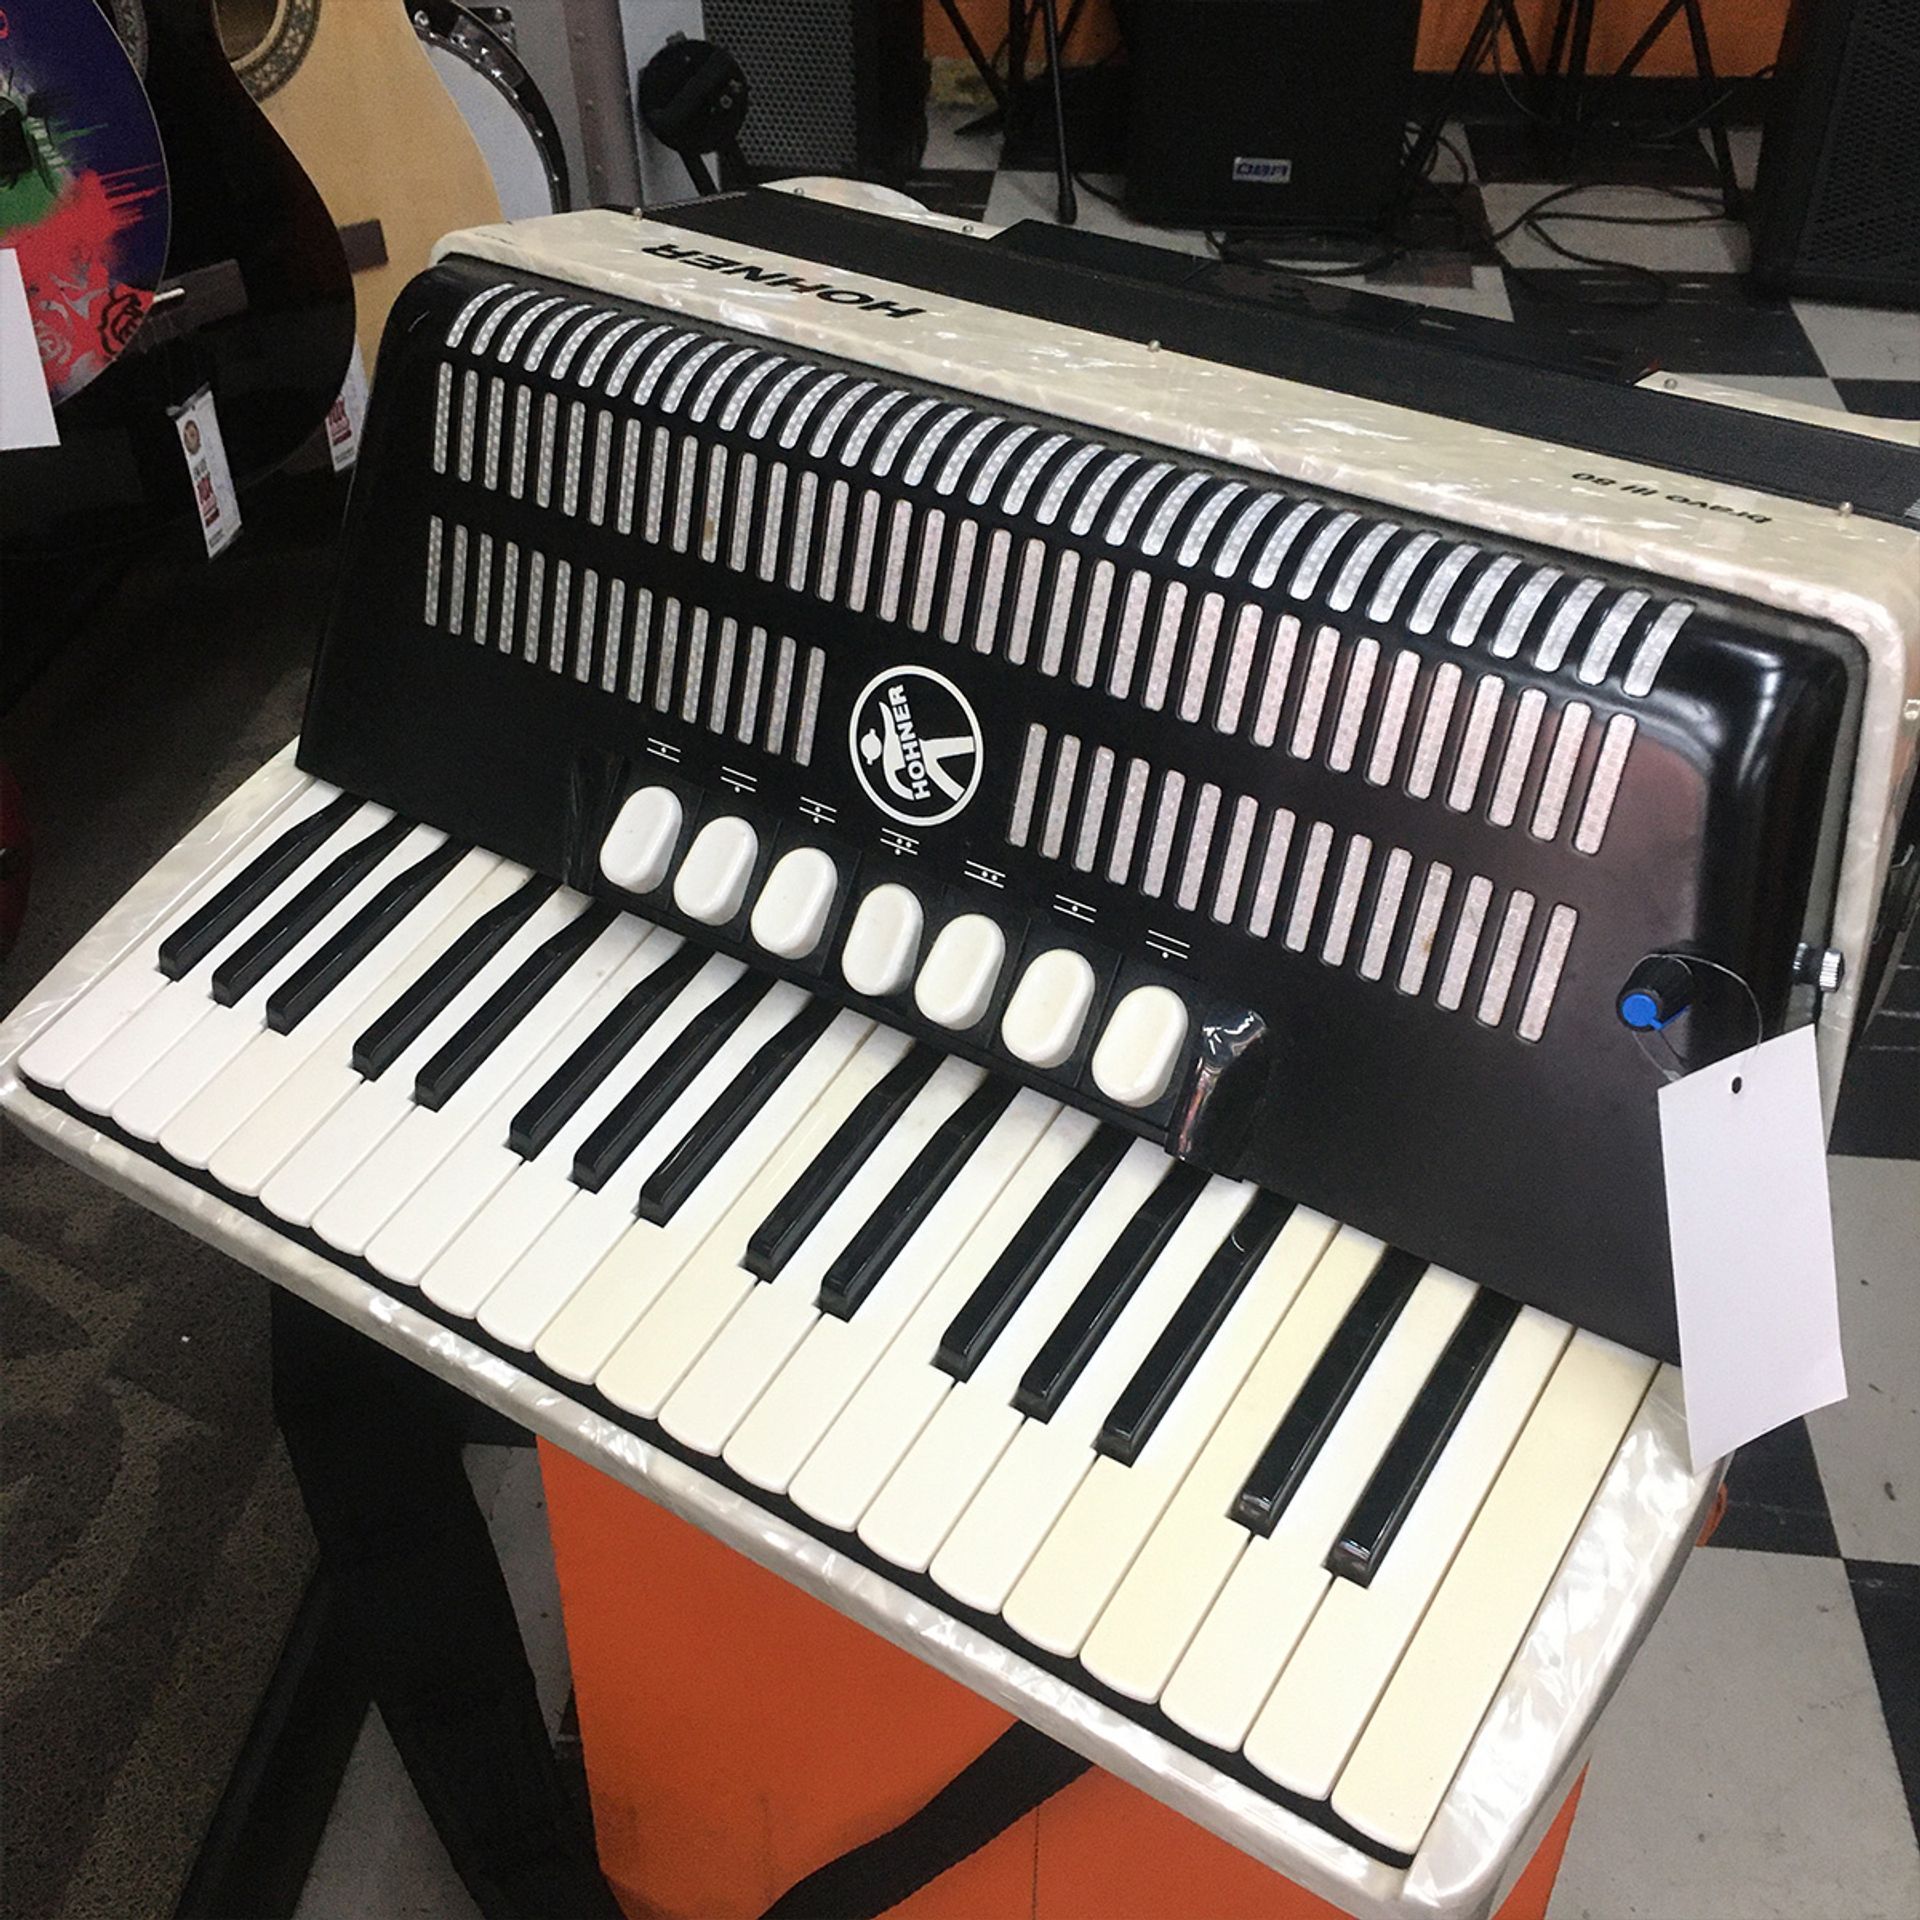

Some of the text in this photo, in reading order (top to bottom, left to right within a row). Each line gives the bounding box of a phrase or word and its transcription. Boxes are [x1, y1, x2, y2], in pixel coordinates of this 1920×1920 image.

[641, 243, 927, 318] HOHNER
[1571, 472, 1617, 486] 80
[1665, 494, 1773, 524] bravo
[888, 684, 931, 800] HOHNER
